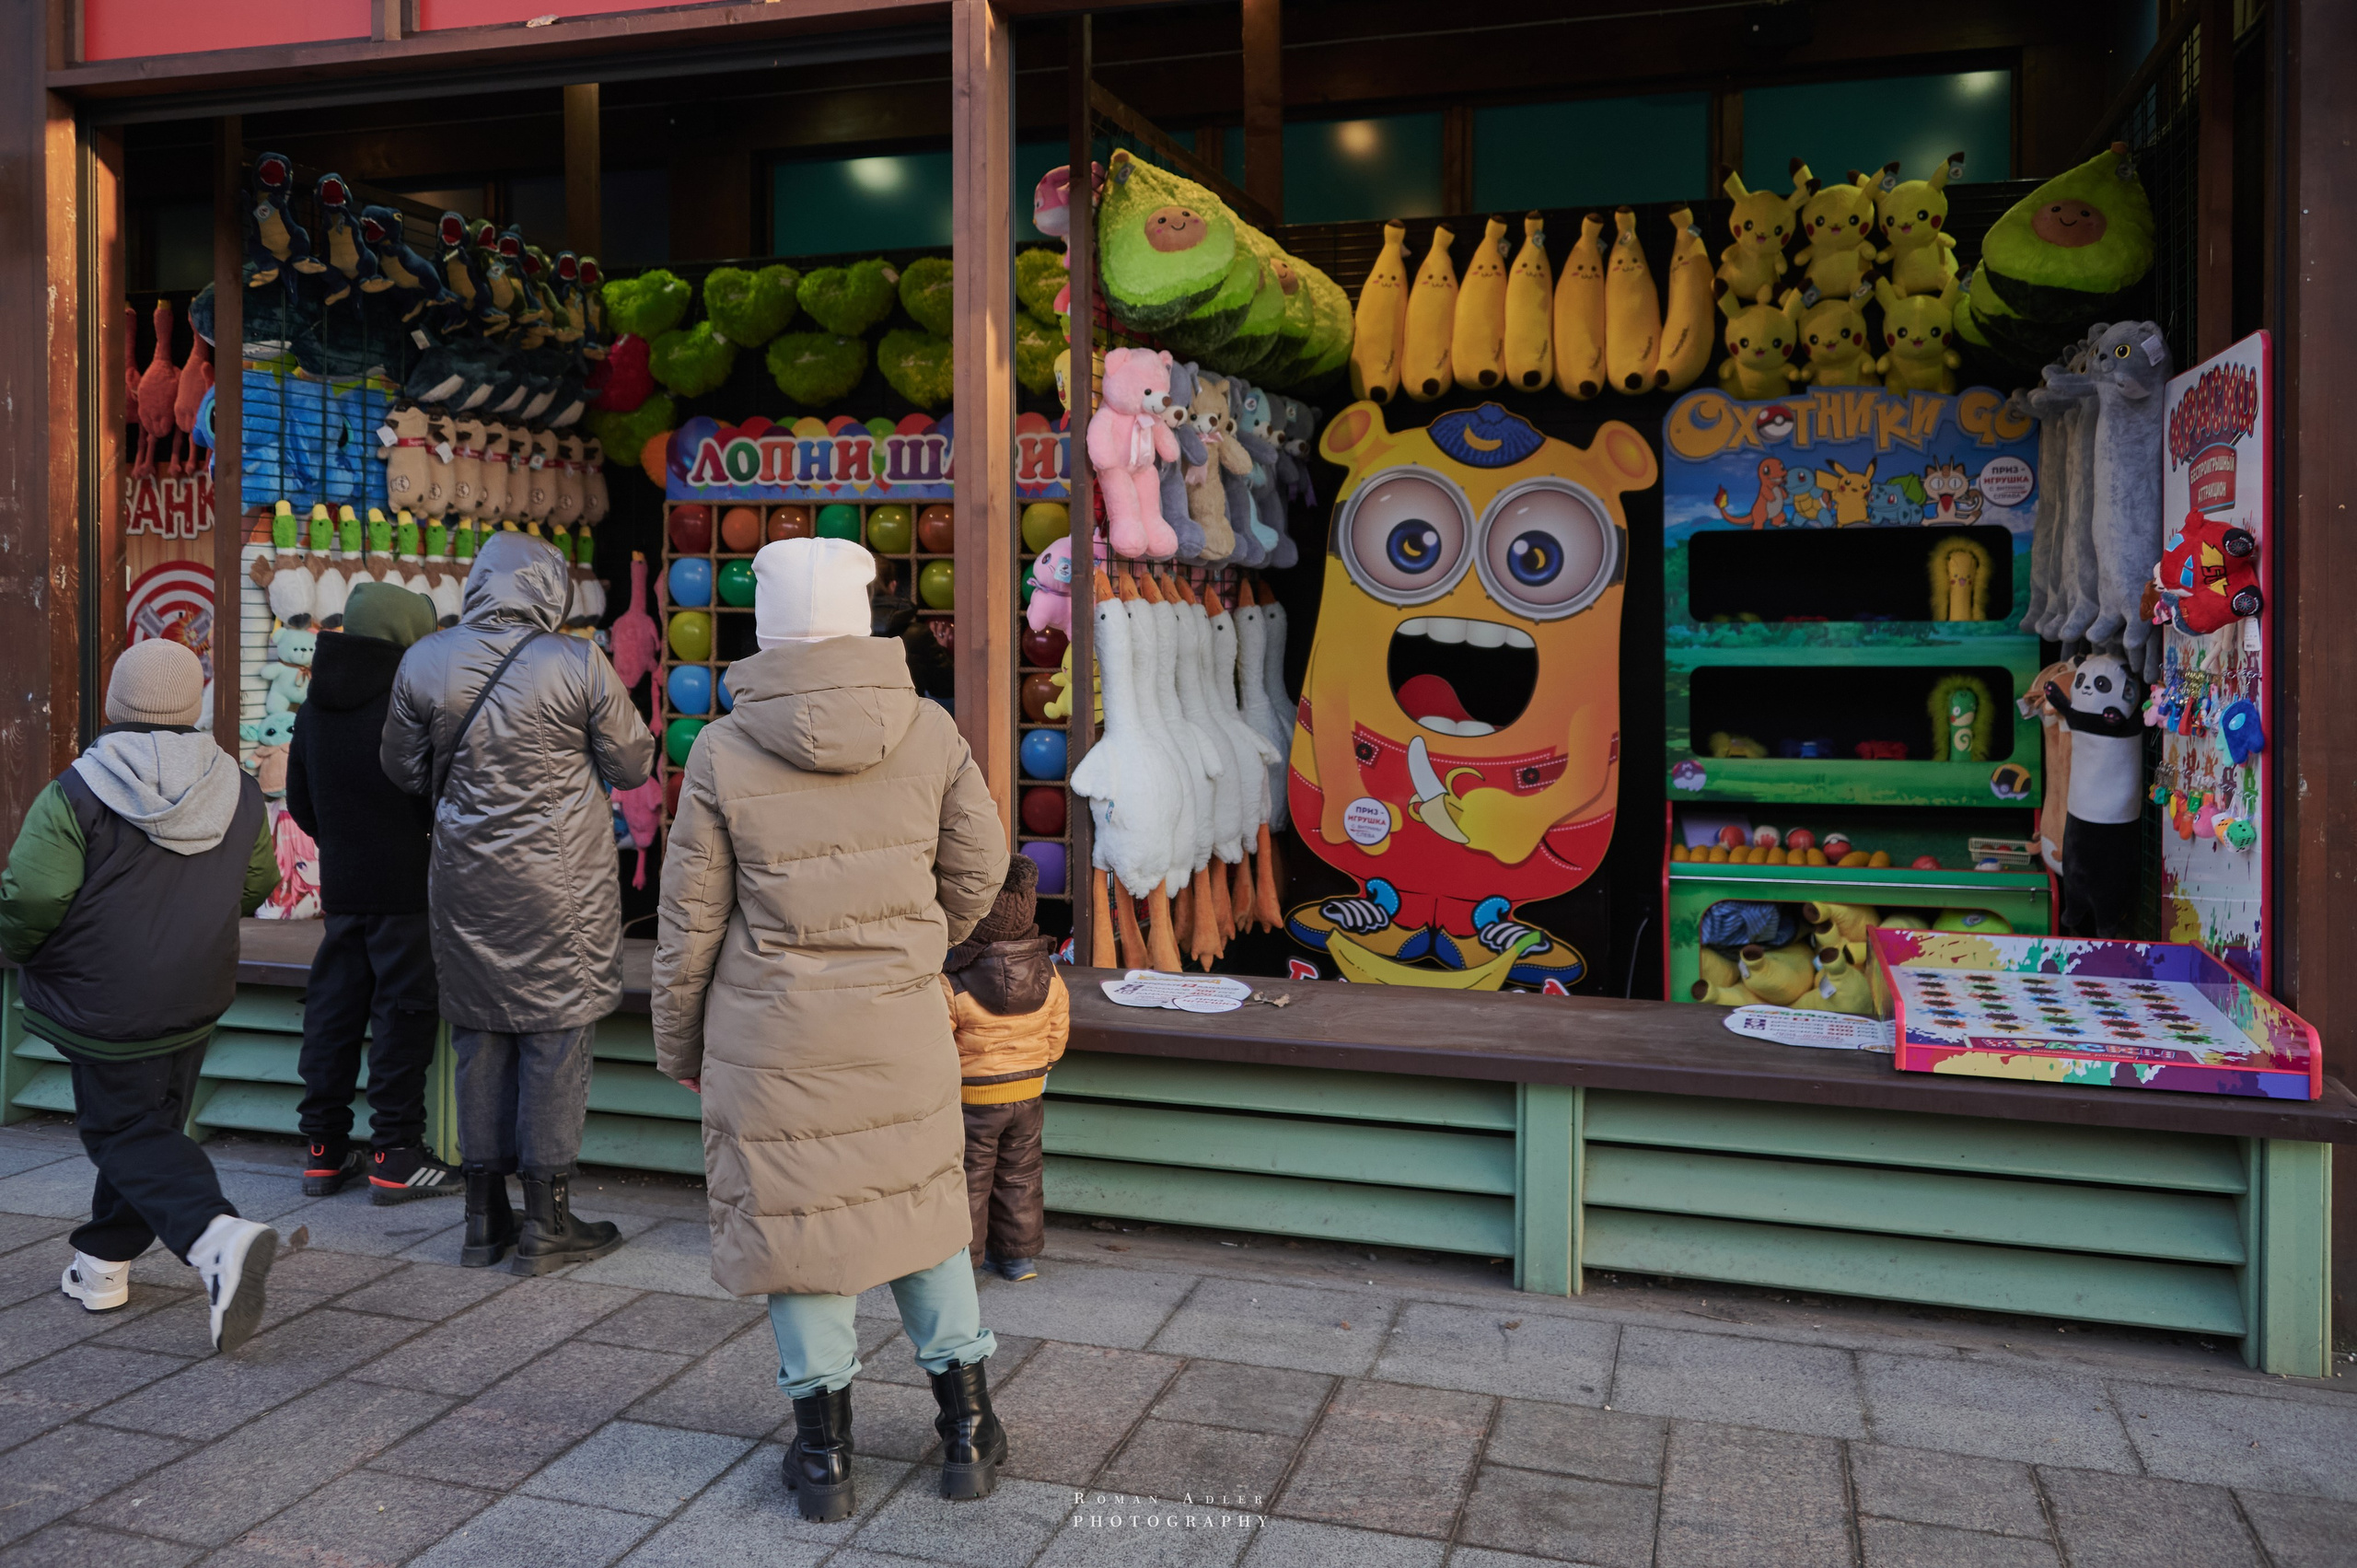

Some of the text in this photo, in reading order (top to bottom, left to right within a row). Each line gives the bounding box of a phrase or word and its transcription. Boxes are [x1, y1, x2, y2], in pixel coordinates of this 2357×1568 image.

[2169, 361, 2257, 472] КРАСКИ
[693, 436, 874, 482] ЛОПНИ
[1991, 465, 2018, 474] ПРИЗ
[1983, 475, 2029, 484] ИГРУШКА
[1355, 807, 1378, 816] ПРИЗ
[1348, 815, 1387, 826] ИГРУШКА
